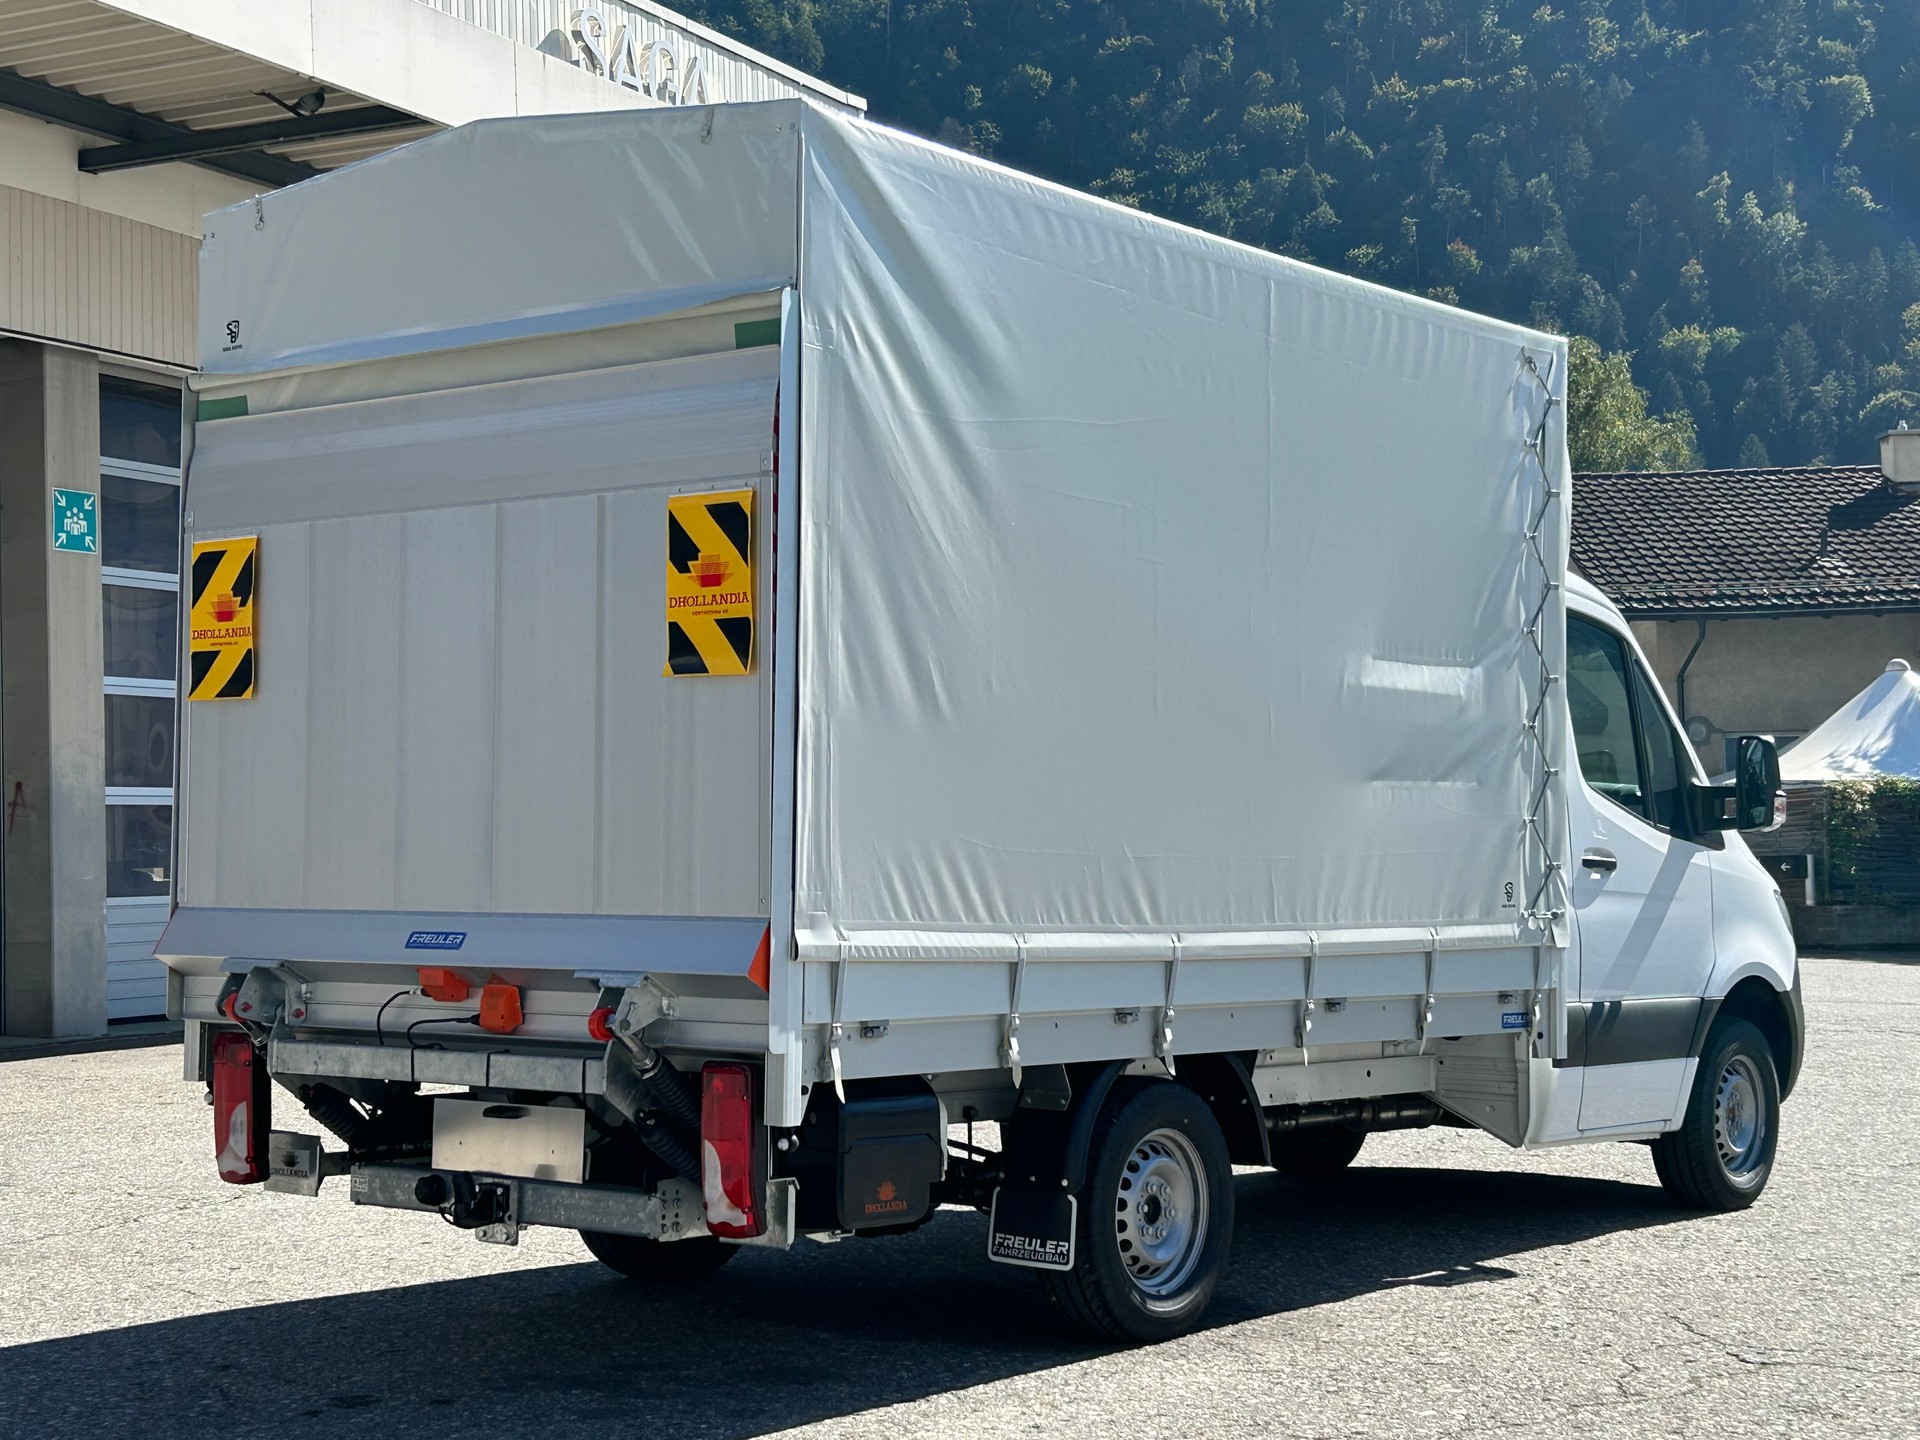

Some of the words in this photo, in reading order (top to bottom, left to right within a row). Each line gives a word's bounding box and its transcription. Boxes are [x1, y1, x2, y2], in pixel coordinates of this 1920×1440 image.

[668, 591, 750, 609] DHOLLANDIA
[192, 627, 253, 640] DHOLLANDIA
[409, 933, 464, 944] FREULER
[995, 1232, 1069, 1255] FREULER
[992, 1245, 1068, 1263] FAHRZEUGBAU
